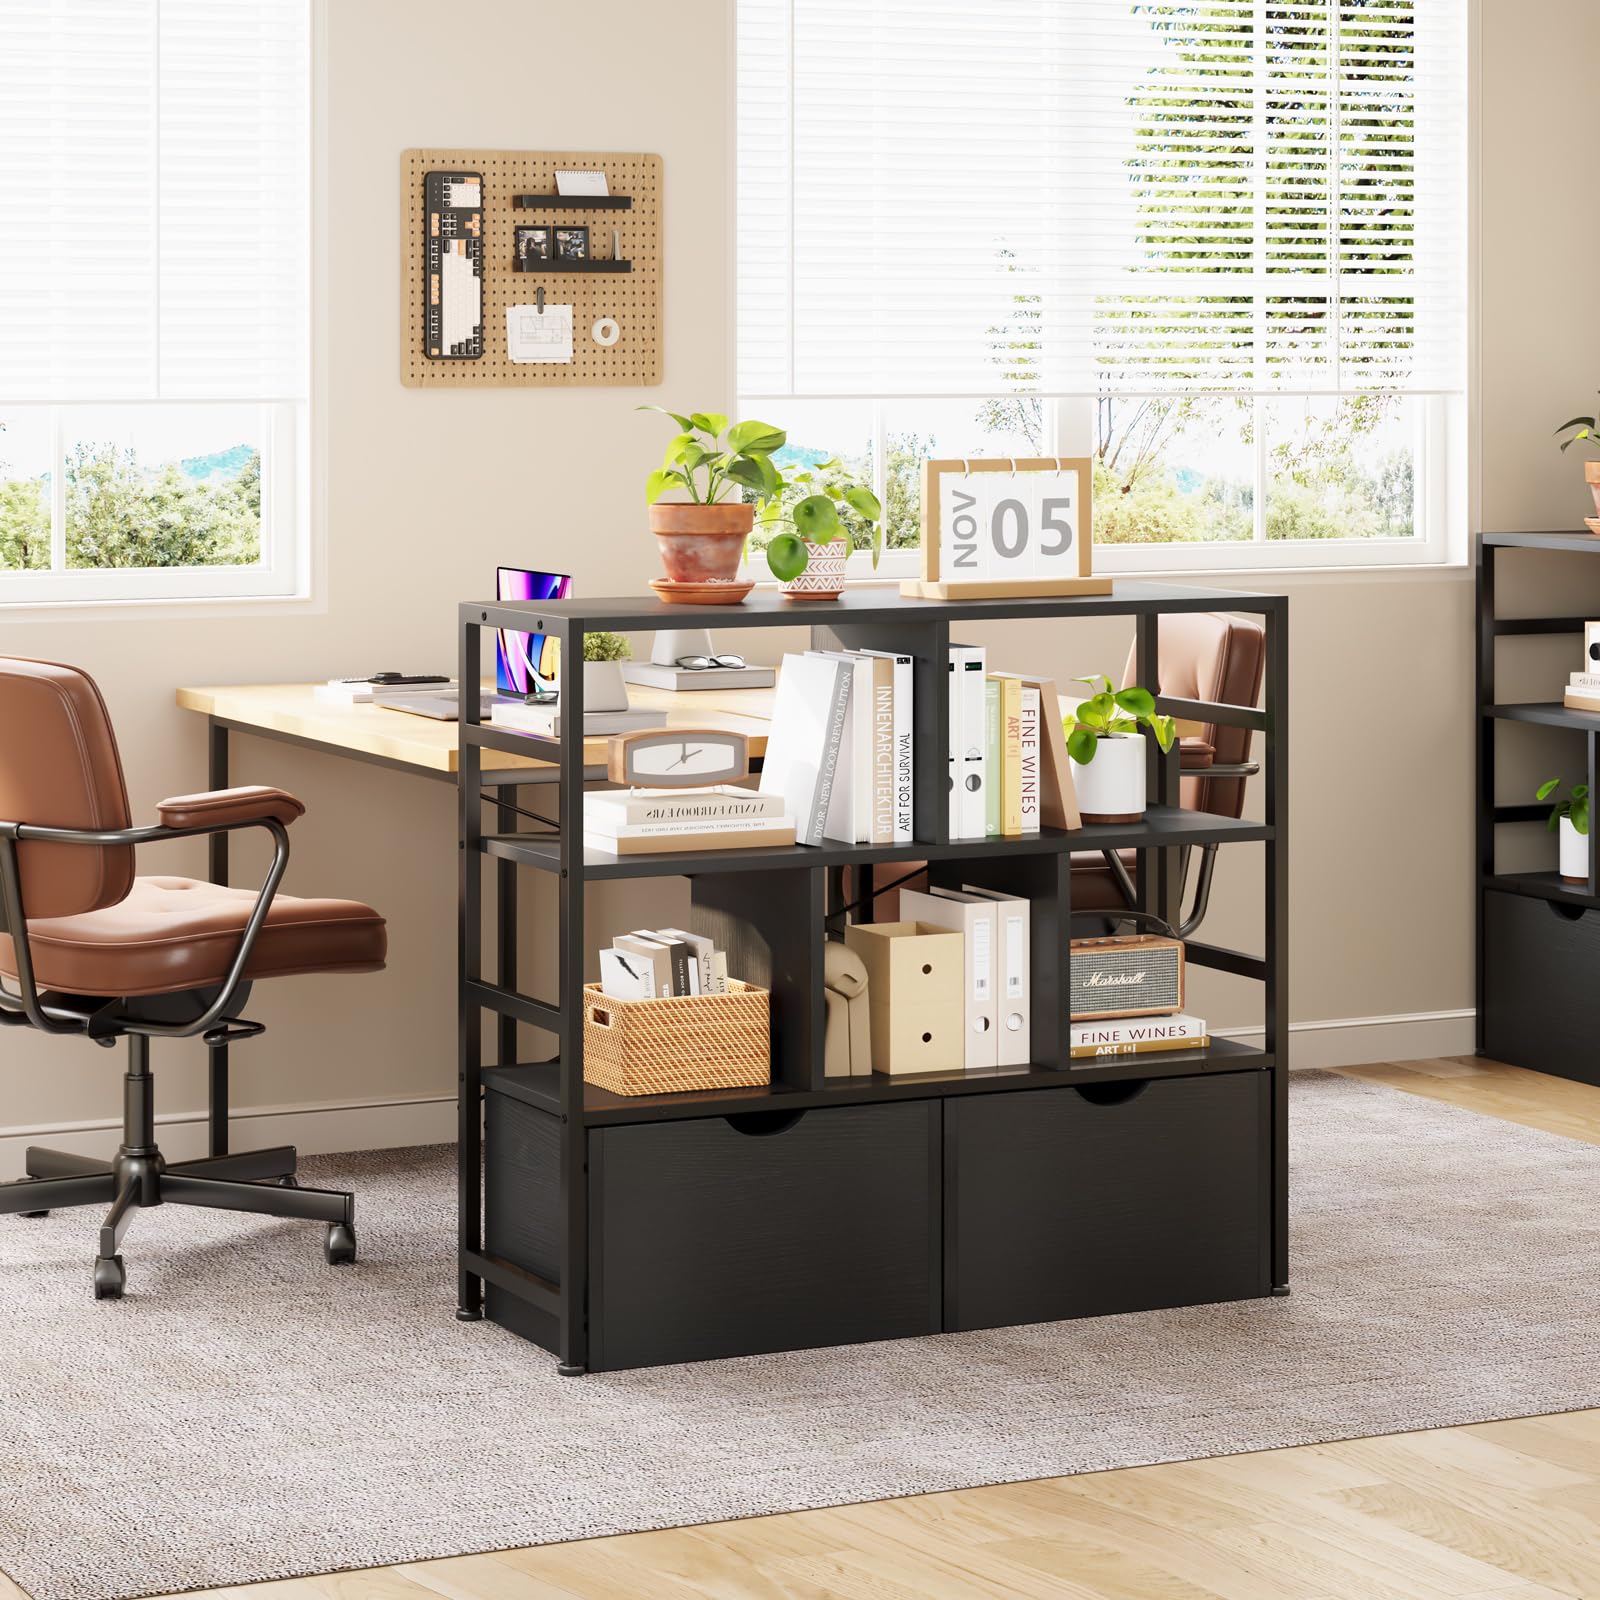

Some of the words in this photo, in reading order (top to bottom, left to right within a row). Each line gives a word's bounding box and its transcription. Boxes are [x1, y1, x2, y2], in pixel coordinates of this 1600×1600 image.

[952, 489, 978, 568] NOV
[991, 497, 1073, 559] 05
[832, 671, 851, 744] REVOLUTION
[1007, 716, 1020, 740] ART
[1021, 709, 1036, 748] FINE
[826, 745, 839, 777] LOOK
[876, 685, 893, 836] INNENARCHITEKTUR
[899, 733, 911, 782] SURVIVAL
[820, 779, 833, 806] NEW
[898, 784, 911, 807] FOR
[1021, 756, 1036, 814] WINES
[898, 809, 911, 832] ART
[1083, 971, 1147, 987] Marshall
[1081, 1030, 1121, 1044] FINE
[1129, 1025, 1187, 1040] WINES
[1096, 1045, 1120, 1056] ART
